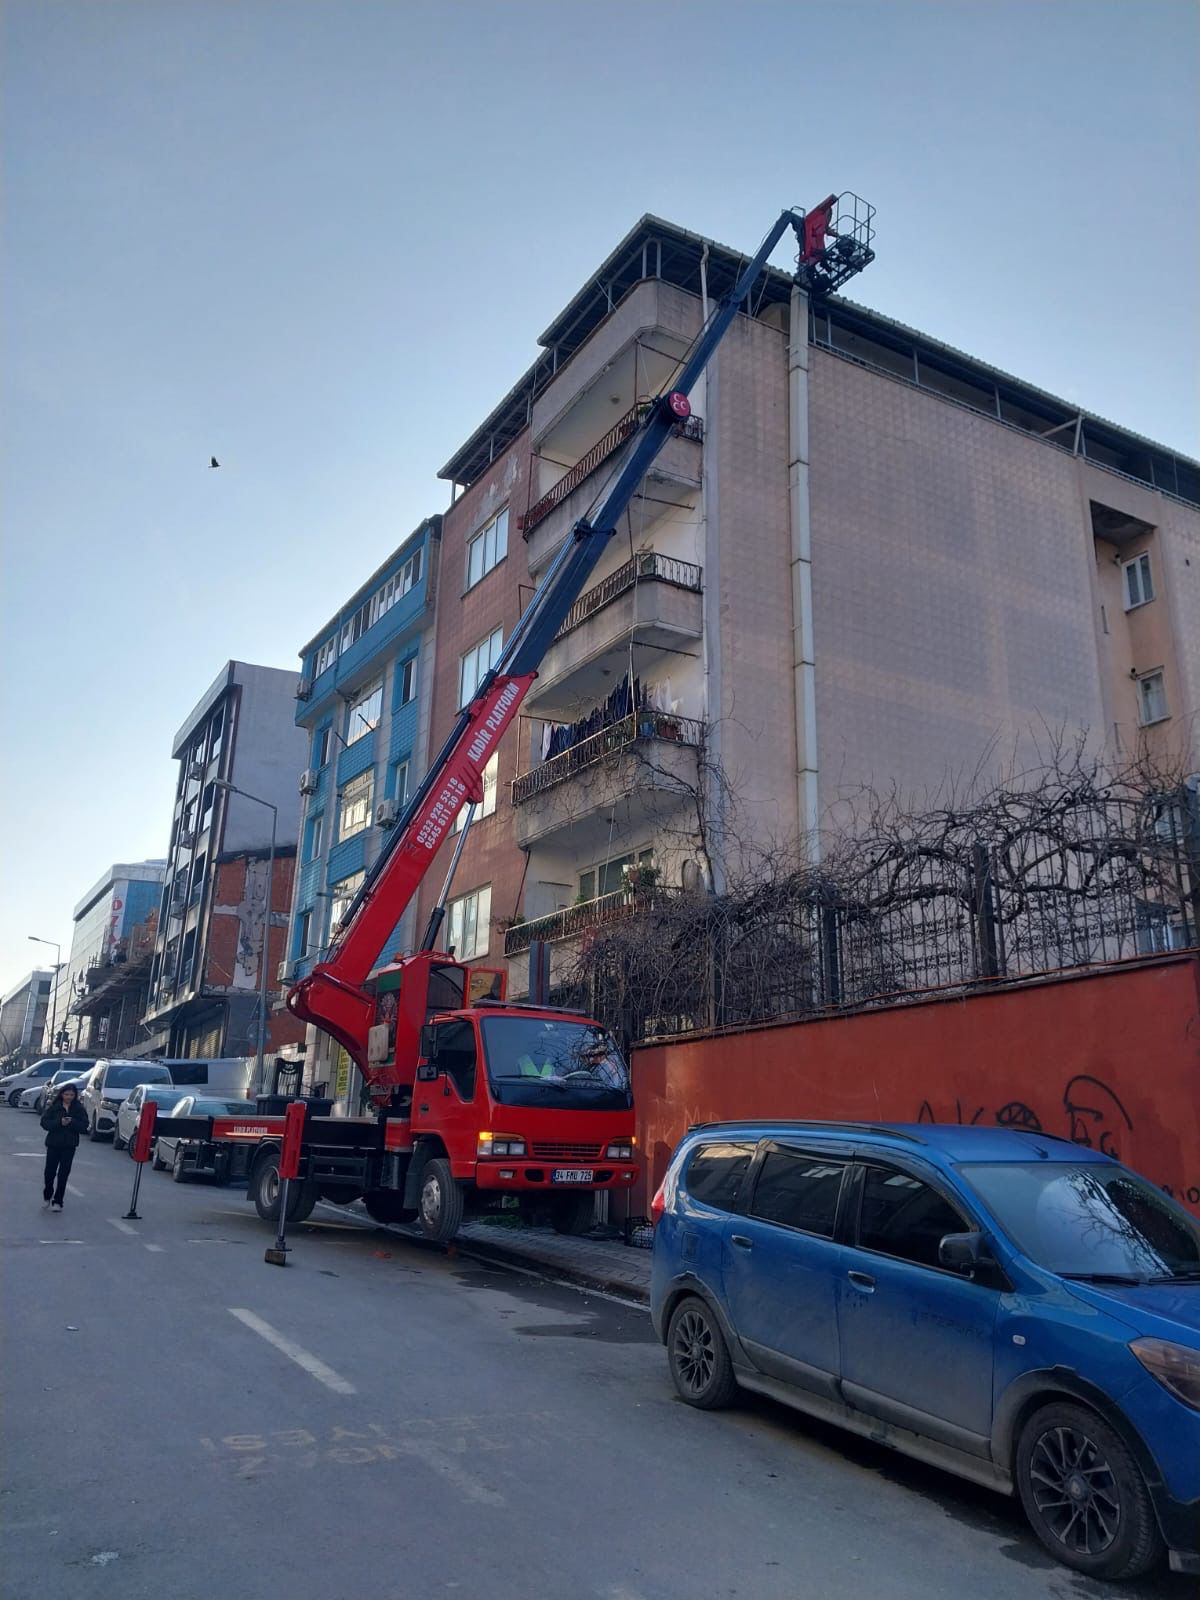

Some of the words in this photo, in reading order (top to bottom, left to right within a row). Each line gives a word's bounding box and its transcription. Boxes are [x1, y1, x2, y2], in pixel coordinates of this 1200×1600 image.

[467, 729, 493, 762] KADİR
[486, 682, 520, 731] PLATFORM
[416, 820, 434, 844] 0533
[430, 802, 444, 820] 928
[440, 789, 451, 803] 53
[447, 777, 458, 790] 18
[447, 795, 459, 809] 30
[455, 783, 466, 796] 18
[555, 1171, 564, 1180] 34
